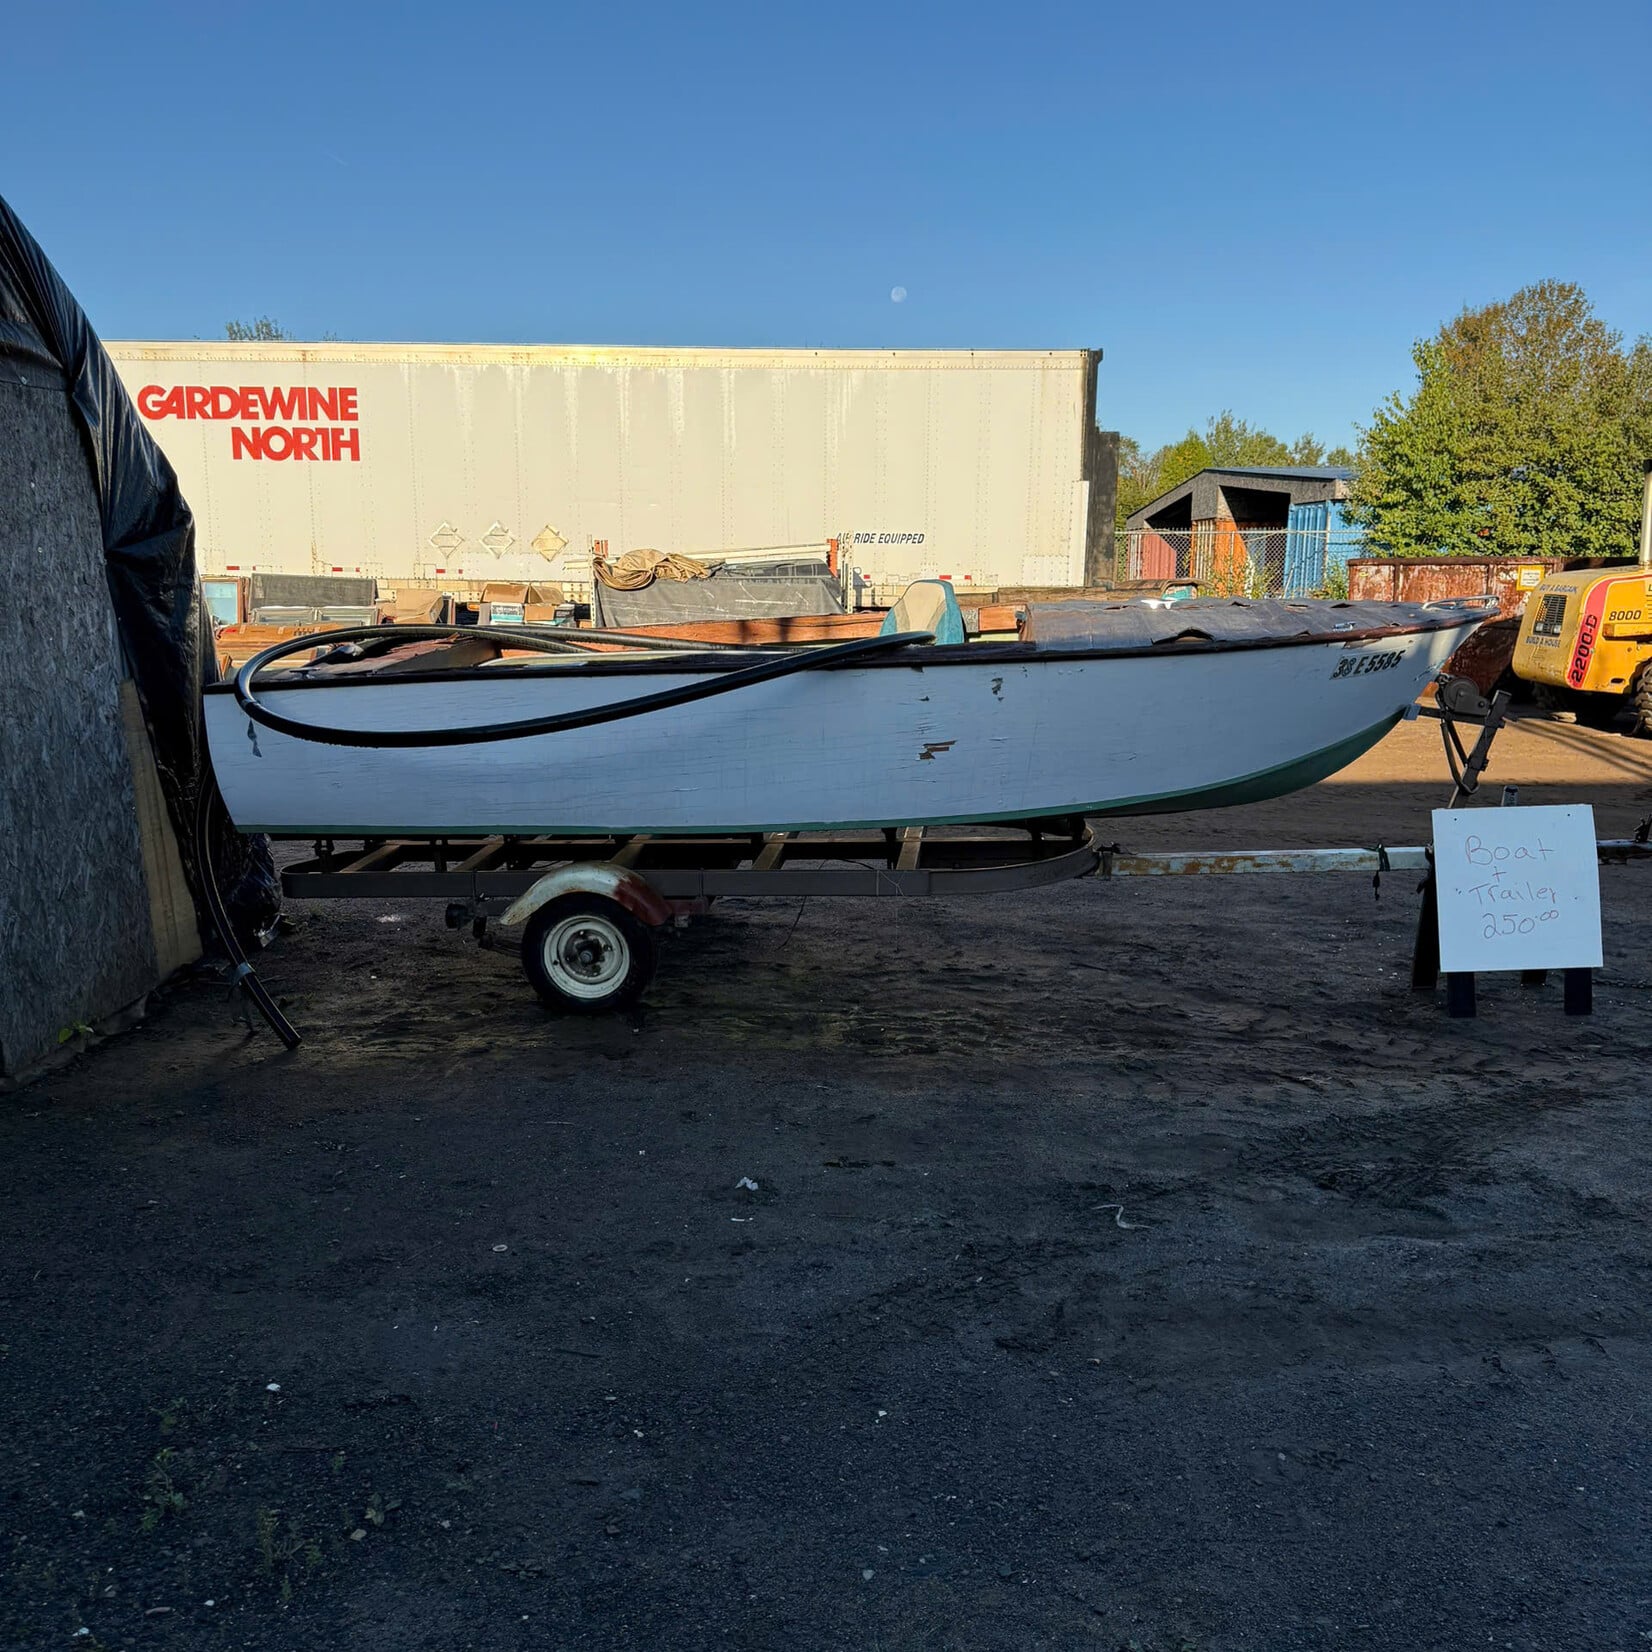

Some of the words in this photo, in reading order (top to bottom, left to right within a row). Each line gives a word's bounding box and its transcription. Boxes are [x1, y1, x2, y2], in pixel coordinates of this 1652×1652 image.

[138, 385, 359, 421] GARDEWINE
[231, 426, 361, 461] NORTH
[853, 533, 877, 544] RIDE
[878, 533, 925, 544] EQUIPPED
[1609, 610, 1642, 621] 8000
[1571, 614, 1598, 683] 2200-D
[1465, 835, 1555, 866] Boat
[1469, 881, 1556, 904] Trailer
